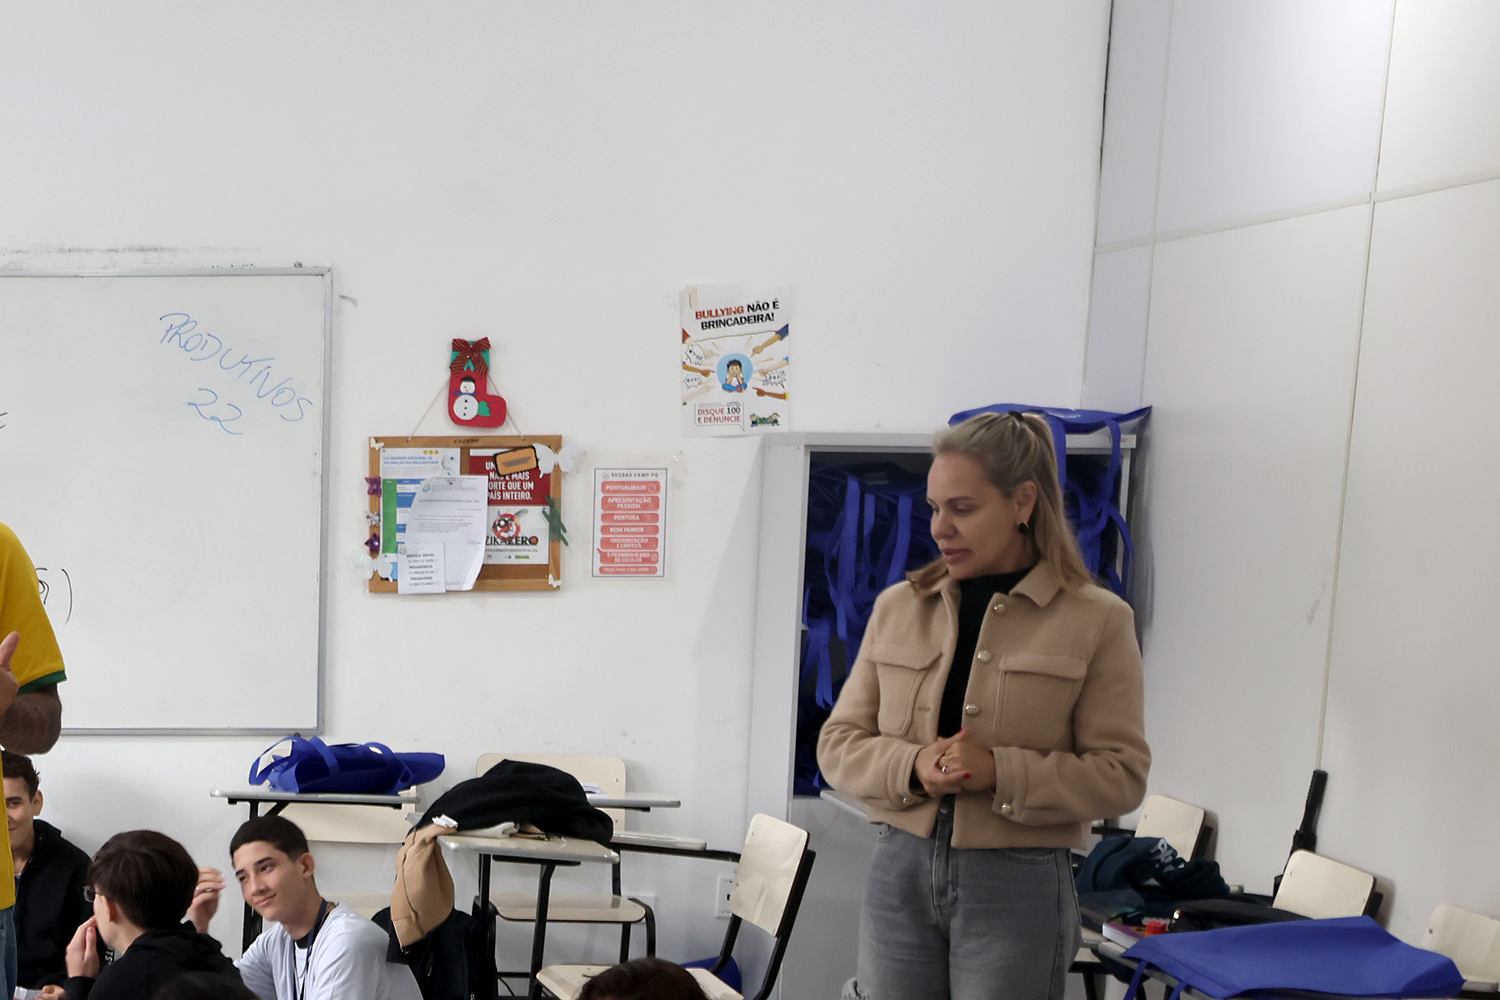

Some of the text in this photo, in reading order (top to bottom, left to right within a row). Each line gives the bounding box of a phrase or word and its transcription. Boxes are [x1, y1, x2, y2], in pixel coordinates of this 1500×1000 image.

[695, 298, 780, 320] BULLYING NÃO É
[701, 313, 774, 330] BRINCADEIRA!
[187, 388, 243, 435] 22
[698, 407, 740, 416] DISQUE 100
[704, 416, 740, 424] DENUNCIE
[488, 482, 534, 490] ORTE QUE UM
[503, 491, 532, 500] INTEIRO.
